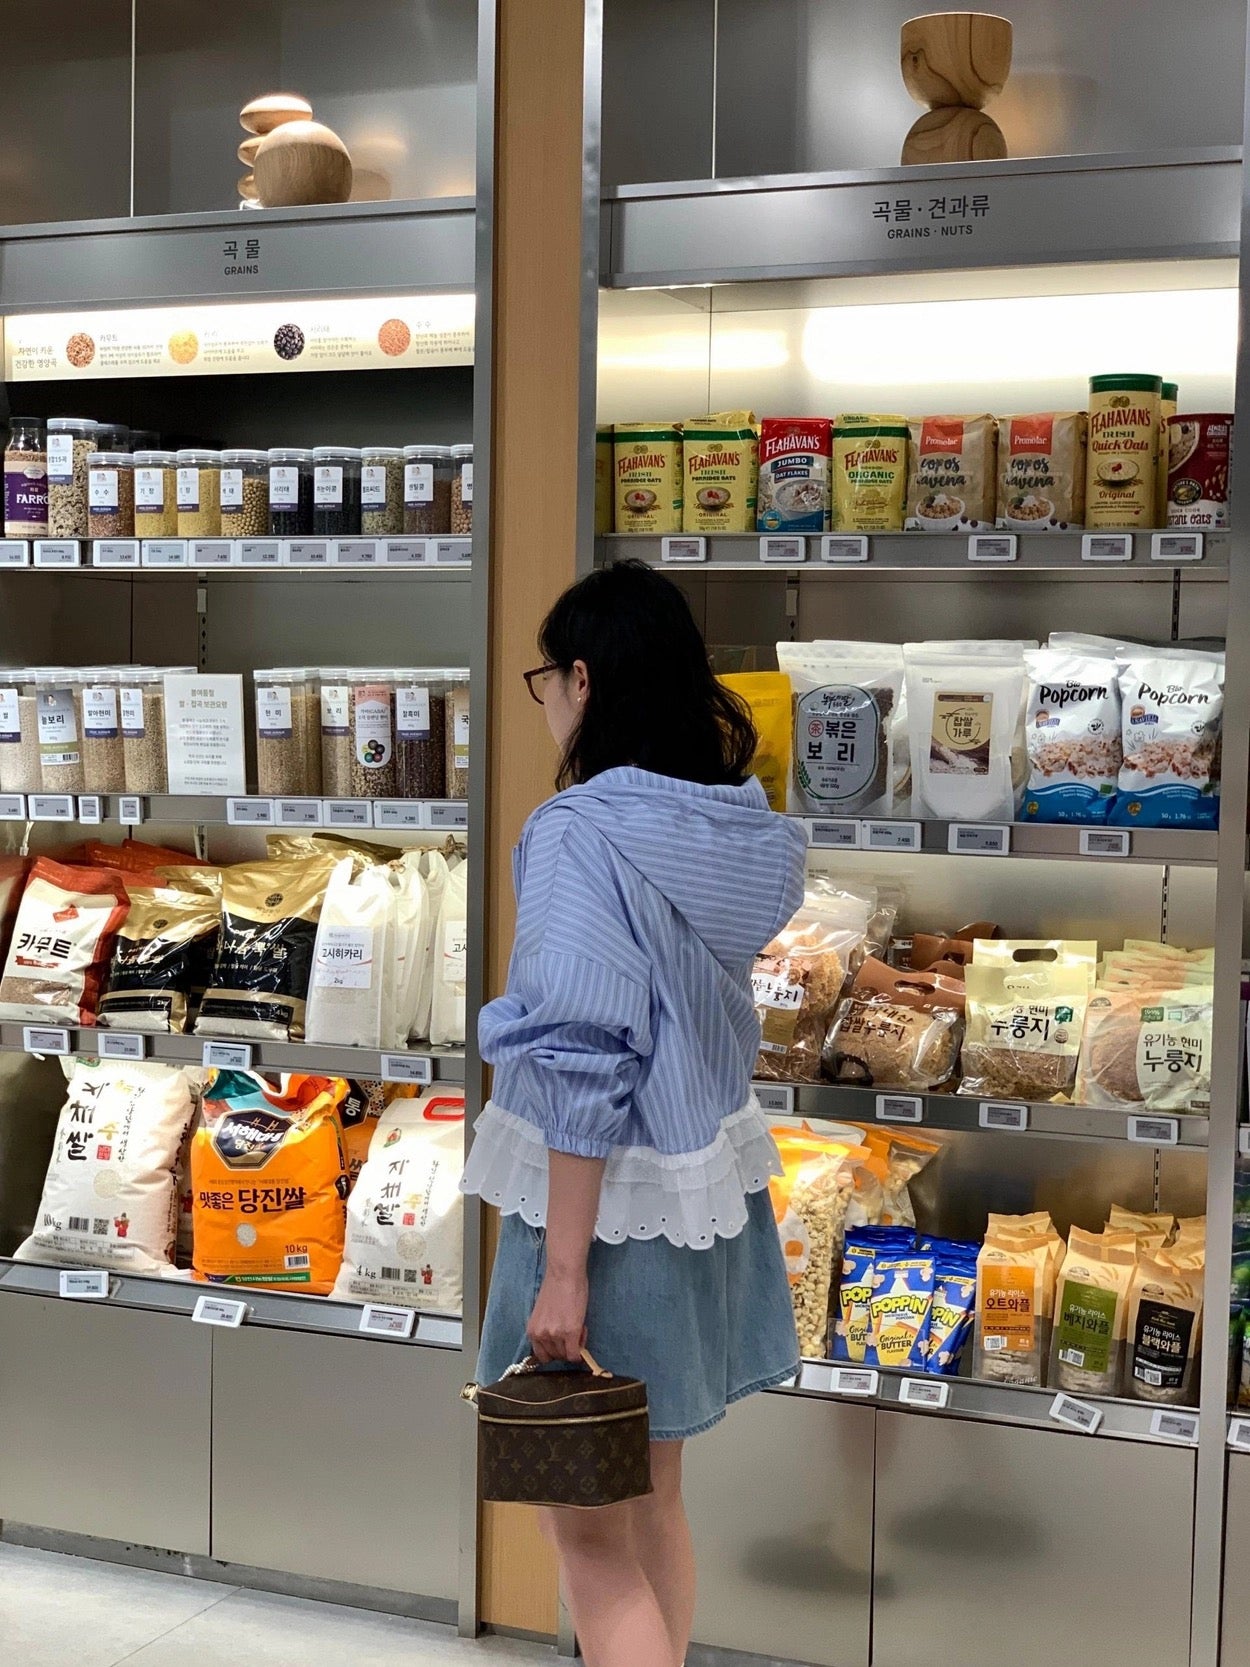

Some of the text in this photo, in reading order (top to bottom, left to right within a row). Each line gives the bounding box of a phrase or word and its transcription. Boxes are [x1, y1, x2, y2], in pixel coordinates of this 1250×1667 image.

[887, 225, 973, 239] GRAINS NUTS
[224, 265, 258, 275] GRAINS
[1091, 408, 1151, 438] FLAHAVAN'S
[766, 435, 821, 457] FLAHAVAN'S
[1092, 438, 1149, 452] Quick Oats
[618, 454, 666, 476] FLAHAVAN'S
[689, 452, 740, 475] FLAHAVAN'S
[777, 459, 807, 467] JUMBO
[845, 449, 899, 471] FLAHAVAN'S
[1099, 491, 1136, 500] Original
[1066, 680, 1081, 688] Bio
[1039, 684, 1110, 709] Popcorn
[1138, 682, 1212, 707] Popcorn
[825, 720, 856, 739] 볶은
[953, 716, 973, 727] 찹쌀
[953, 727, 972, 738] 가루
[17, 933, 73, 960] 카무트
[991, 1015, 1050, 1041] 누룽지
[1143, 1033, 1203, 1052] 유기농 현미
[1143, 1049, 1203, 1073] 누룽지
[200, 1187, 307, 1213] 맛좋은 당진쌀
[990, 1288, 1026, 1297] 유기농 라이스
[985, 1297, 1030, 1313] 오트와플
[1069, 1303, 1106, 1319] 유기농 라이스
[1064, 1312, 1110, 1335] 베지와플
[1143, 1324, 1181, 1342] 유기농 라이스
[881, 1340, 912, 1351] BUTTER
[1142, 1333, 1182, 1354] 블랙와플
